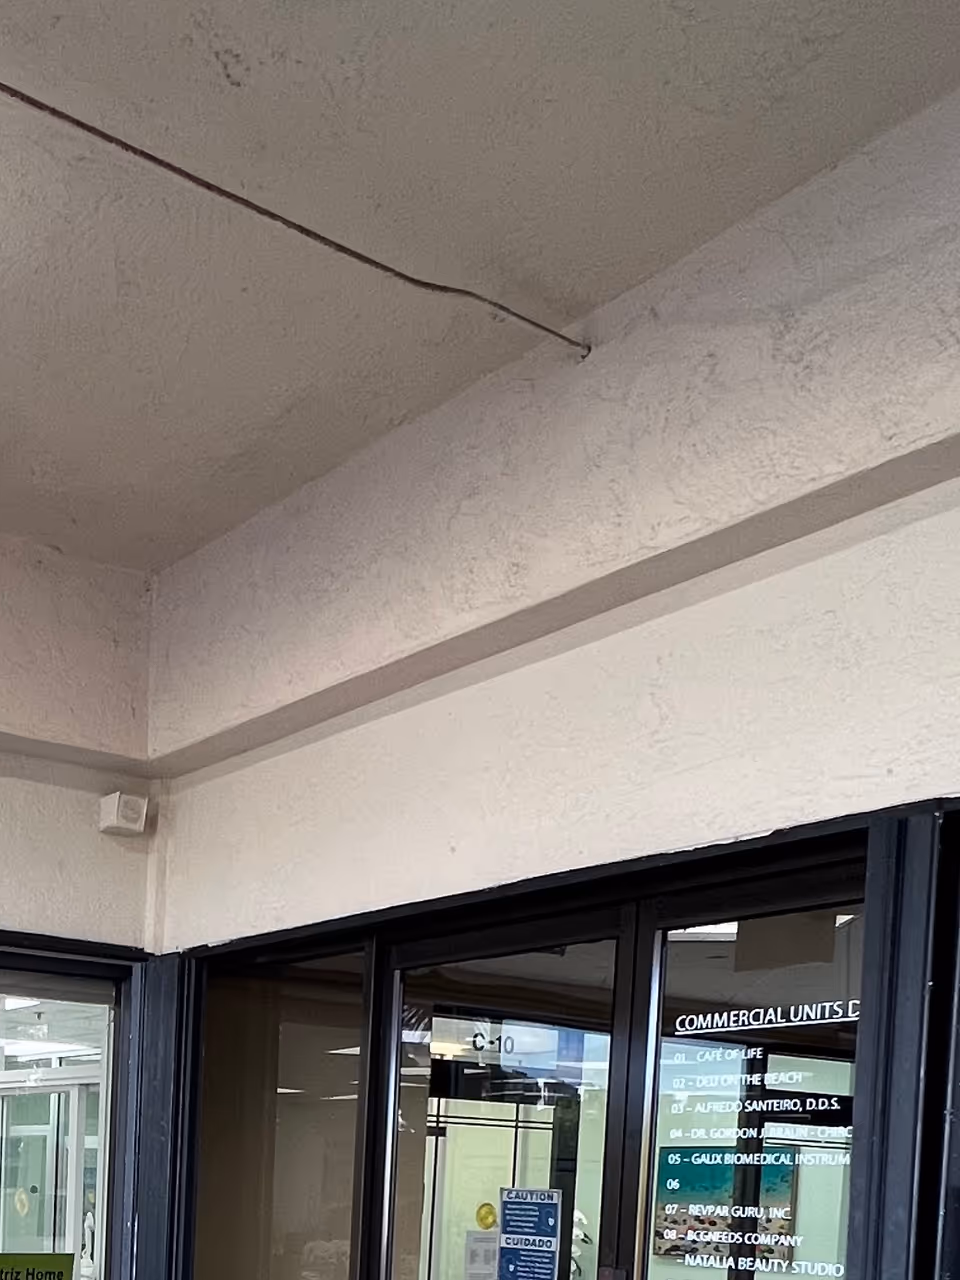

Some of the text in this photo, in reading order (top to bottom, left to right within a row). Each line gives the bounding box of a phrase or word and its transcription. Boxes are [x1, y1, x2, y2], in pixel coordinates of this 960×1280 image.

[676, 1006, 789, 1031] COMMERCIAL
[790, 1001, 843, 1022] UNITS
[472, 1032, 515, 1055] C-10
[724, 1048, 741, 1060] OF
[741, 1047, 764, 1060] LIFE
[741, 1073, 762, 1086] THE
[765, 1072, 803, 1085] BEACH
[671, 1103, 684, 1114] 03
[695, 1101, 742, 1113] ALFREDO
[806, 1097, 841, 1110] D.D.S.
[709, 1128, 758, 1139] GORDON
[668, 1153, 681, 1165] 05
[724, 1153, 794, 1165] BIOMEDICAL
[666, 1179, 680, 1190] 06
[507, 1191, 554, 1201] CAUTION
[664, 1204, 679, 1215] 07
[688, 1204, 730, 1216] REVPAR
[505, 1237, 553, 1249] CUIDADO
[663, 1229, 677, 1241] 08
[744, 1233, 804, 1247] COMPANY
[737, 1257, 790, 1273] BEAUTY
[791, 1261, 845, 1278] STUDIO
[25, 1268, 64, 1280] Home
